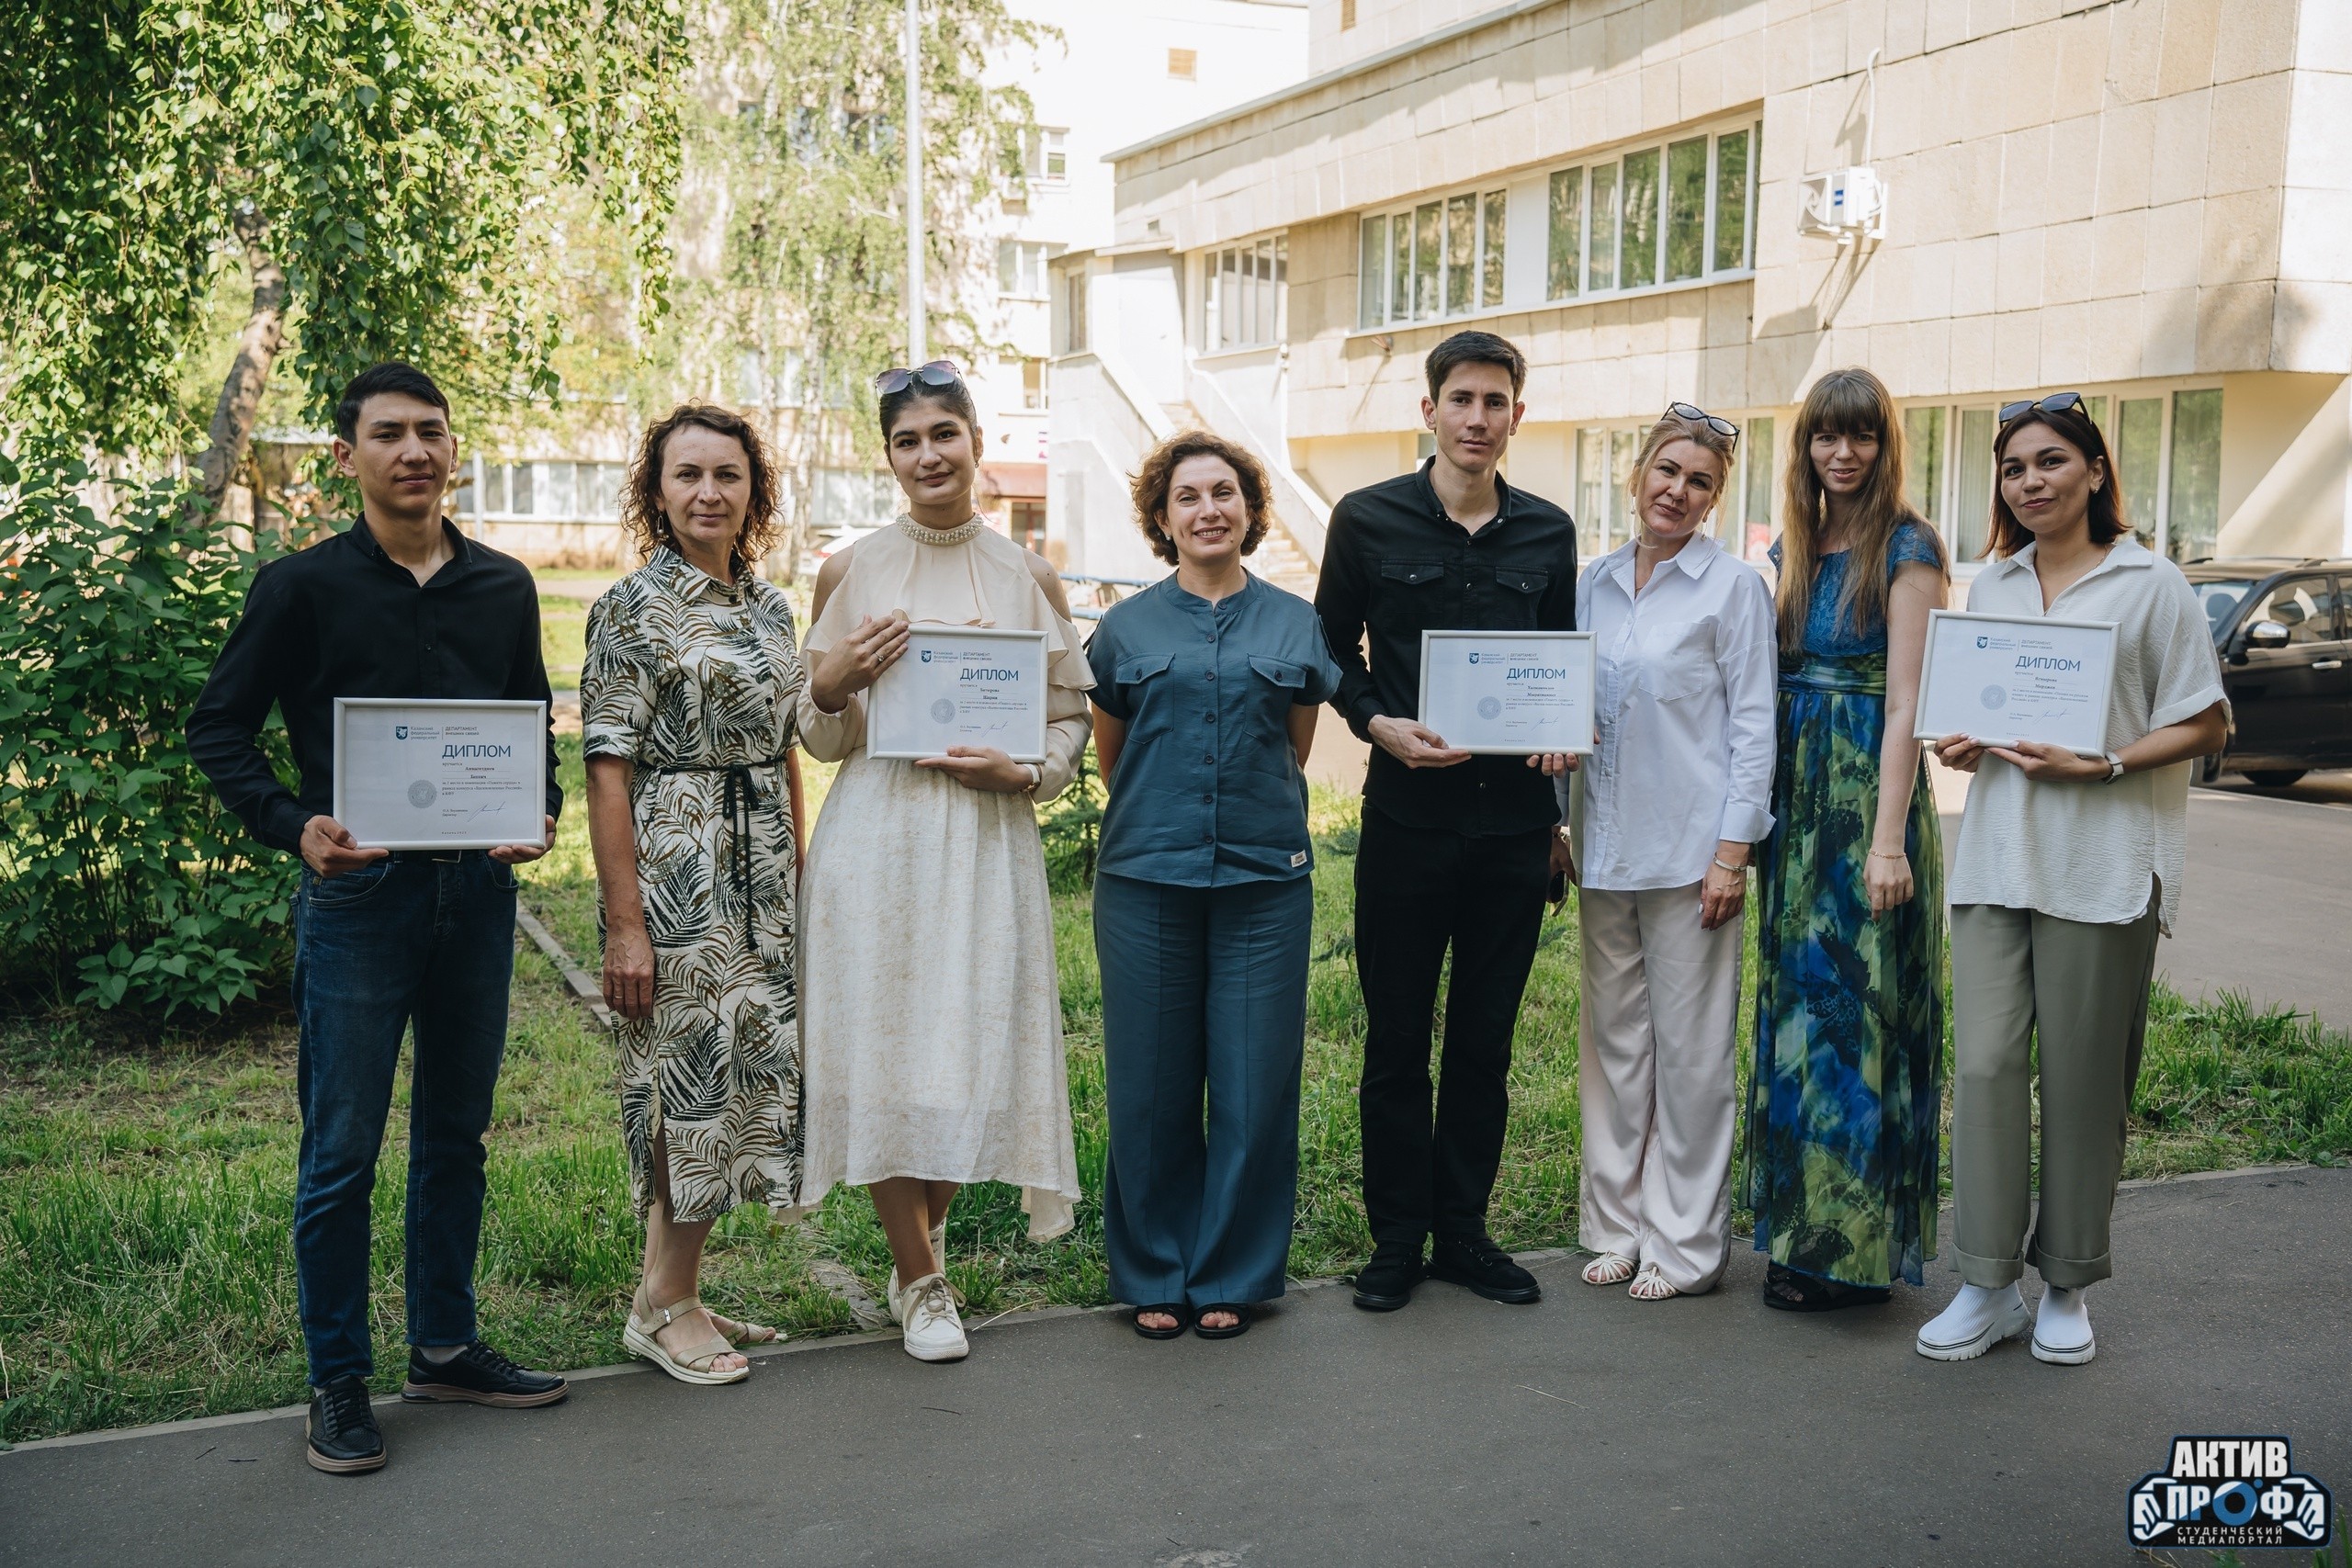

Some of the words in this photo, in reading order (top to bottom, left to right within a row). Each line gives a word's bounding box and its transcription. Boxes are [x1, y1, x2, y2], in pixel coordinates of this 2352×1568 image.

[2015, 655, 2081, 672] ДИПЛОМ
[959, 668, 1019, 682] ДИПЛОМ
[1506, 668, 1566, 680] ДИПЛОМ
[442, 744, 511, 760] ДИПЛОМ
